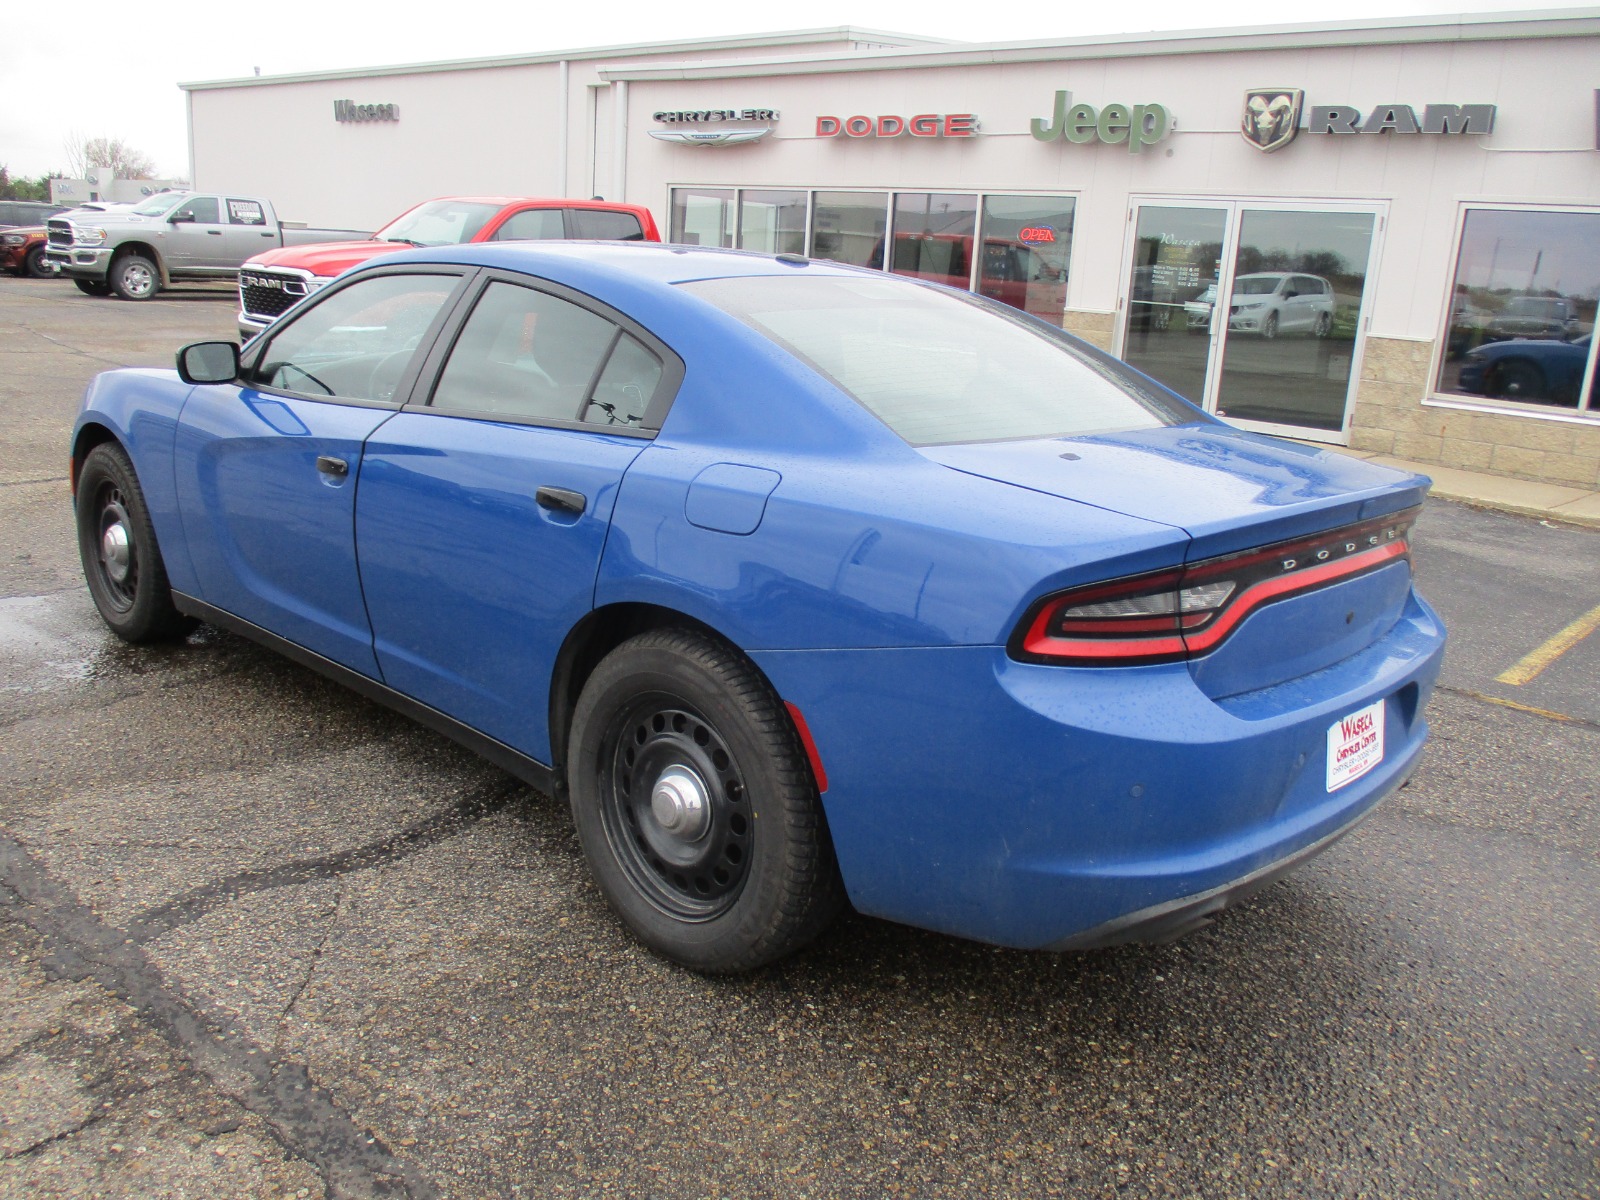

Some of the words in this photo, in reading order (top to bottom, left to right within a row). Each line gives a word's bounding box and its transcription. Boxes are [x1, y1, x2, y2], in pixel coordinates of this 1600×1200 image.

[334, 99, 399, 122] Waseca
[653, 110, 779, 123] CHRYSLER
[1030, 90, 1171, 155] Jeep
[1308, 104, 1496, 135] RAM
[816, 114, 979, 138] DODGE
[1160, 232, 1201, 247] Waseca
[247, 277, 282, 289] RAM
[1283, 530, 1395, 570] DODGE
[1341, 712, 1373, 742] WASECA
